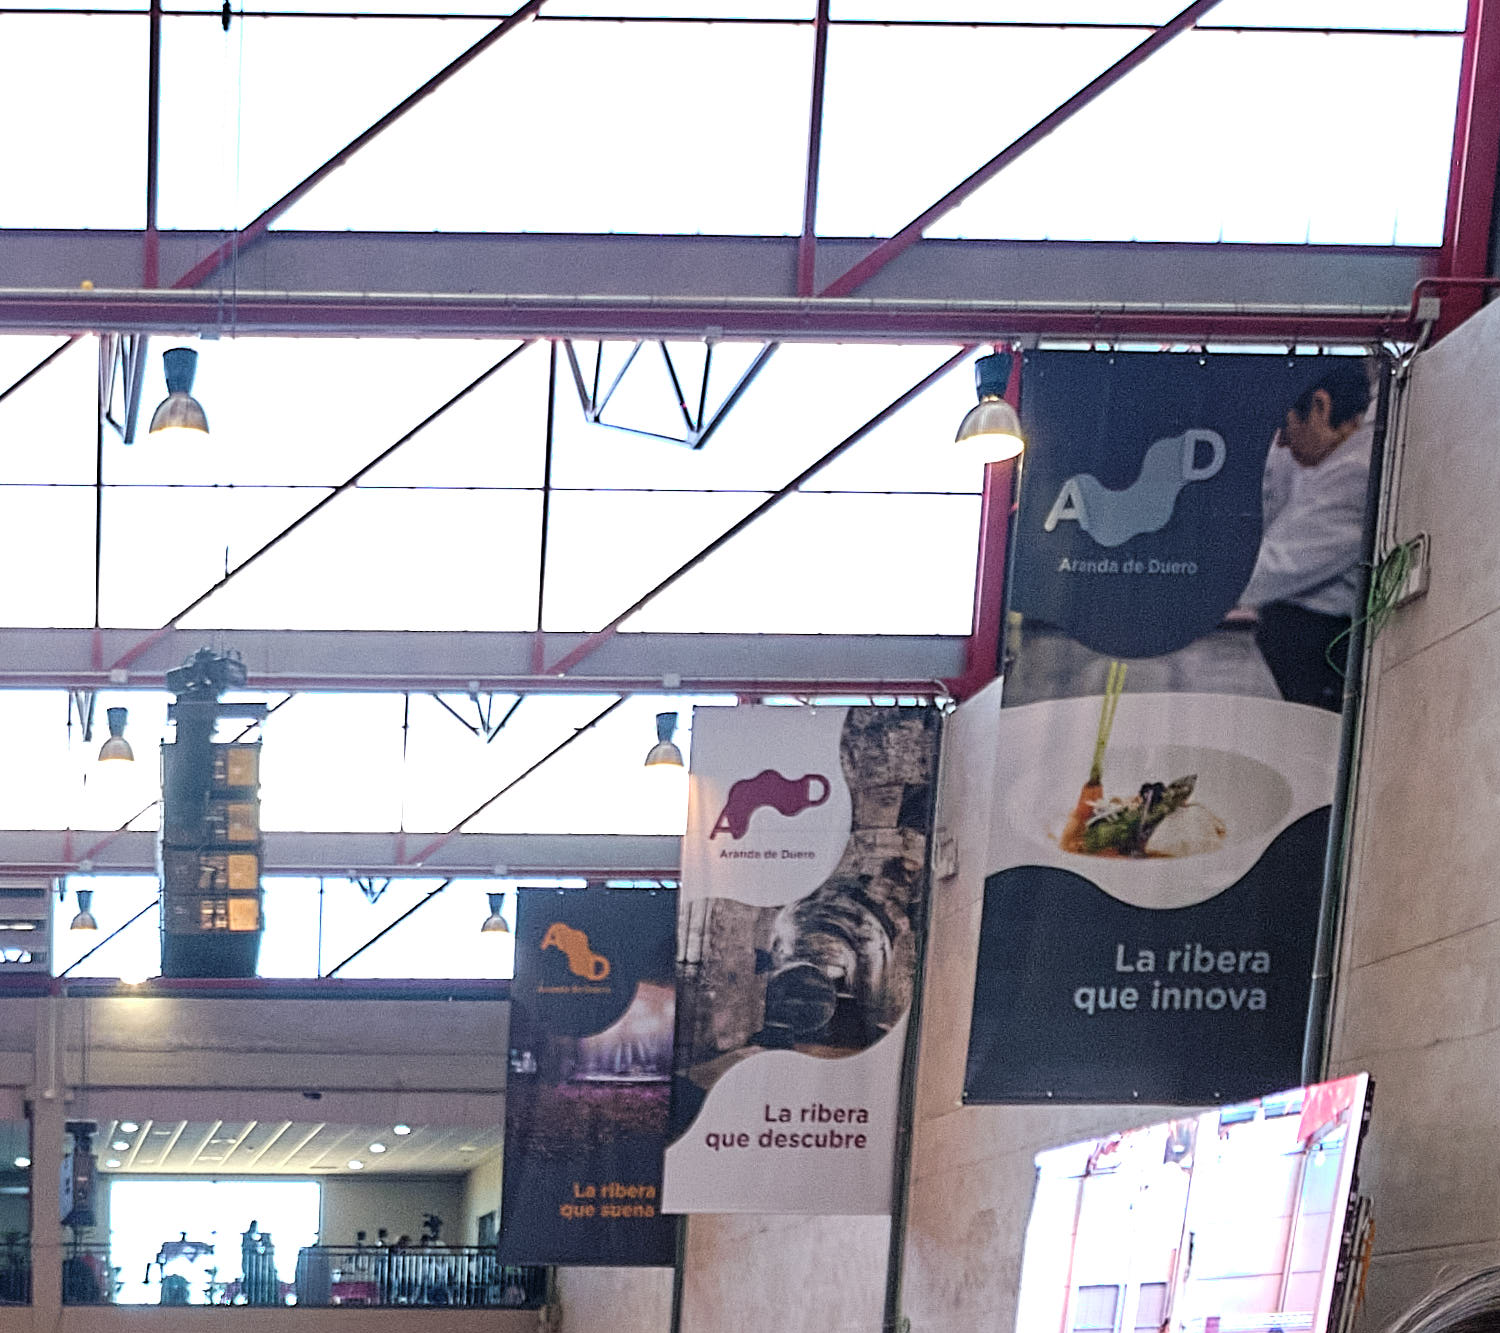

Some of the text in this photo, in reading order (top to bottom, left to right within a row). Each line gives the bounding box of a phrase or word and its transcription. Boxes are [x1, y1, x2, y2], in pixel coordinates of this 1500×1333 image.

[1058, 557, 1198, 576] Aranda de Duero
[1116, 945, 1271, 975] La ribera
[1073, 982, 1268, 1016] que innova
[764, 1103, 869, 1124] La ribera
[705, 1129, 867, 1151] que descubre
[574, 1182, 656, 1199] La ribera
[560, 1204, 594, 1220] que
